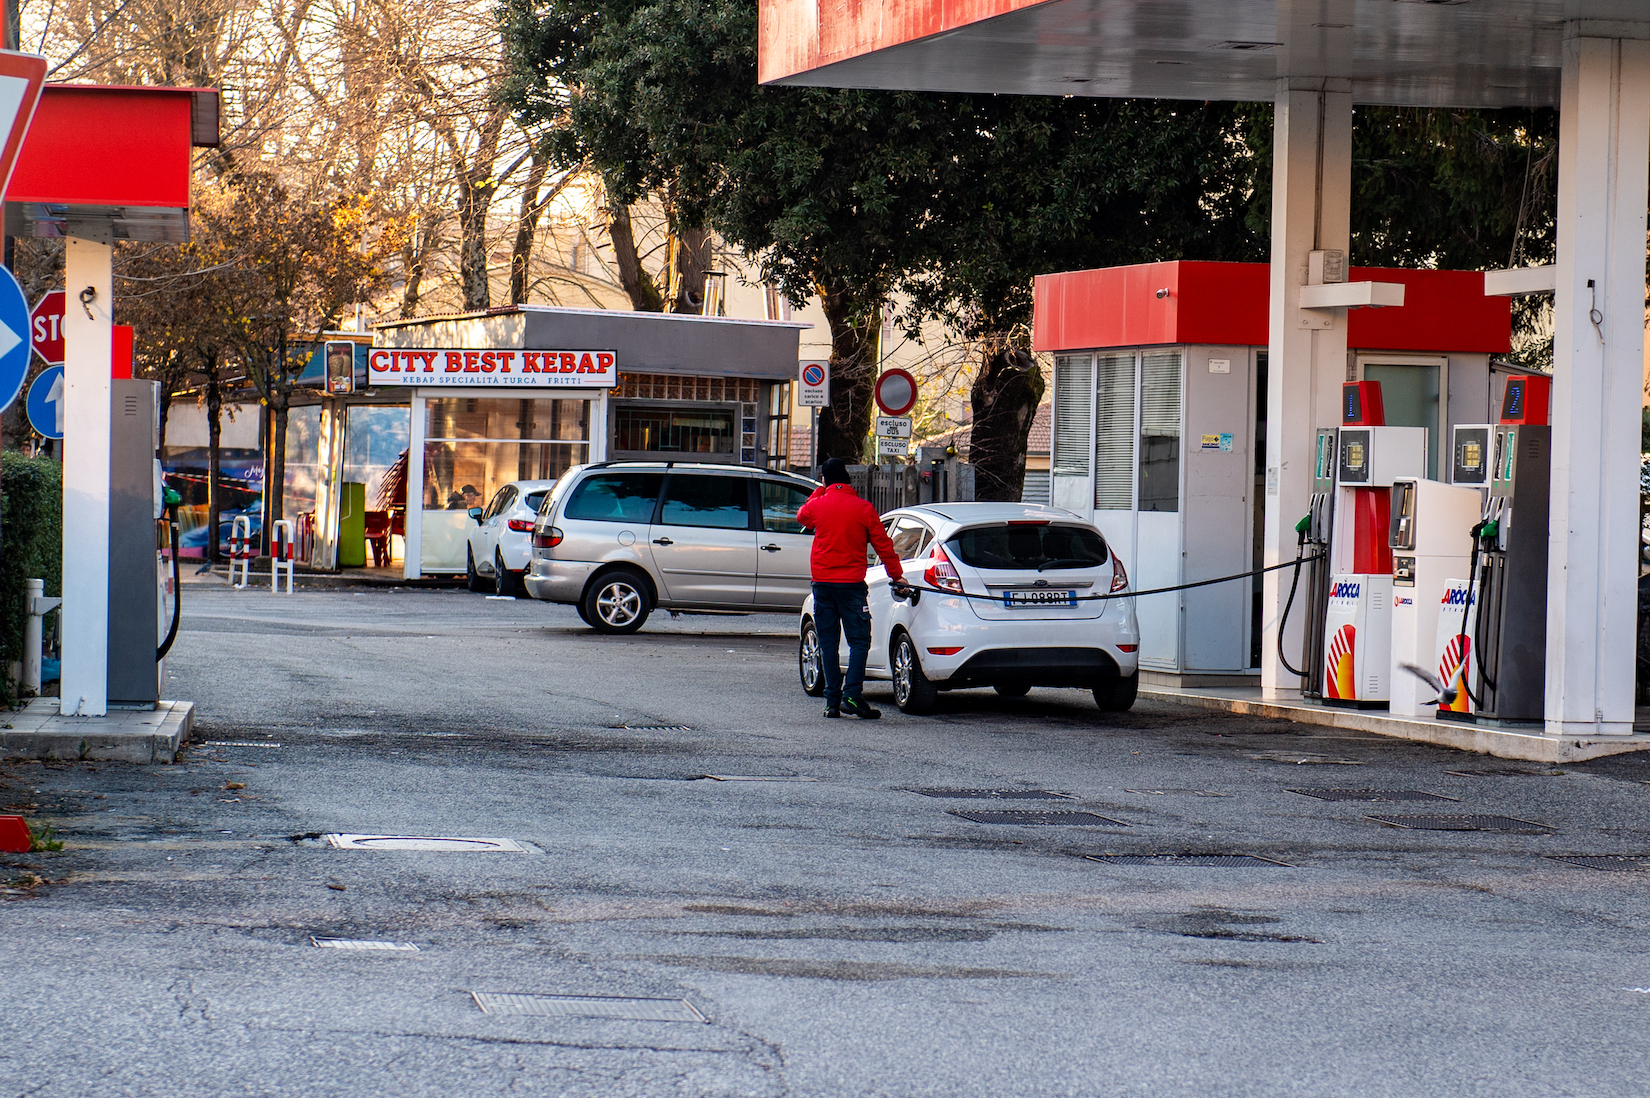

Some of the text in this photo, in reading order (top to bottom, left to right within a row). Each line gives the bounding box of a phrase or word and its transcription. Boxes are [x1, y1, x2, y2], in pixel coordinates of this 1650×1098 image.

[33, 314, 66, 343] ST
[370, 351, 614, 375] CITY BEST KEBAP
[403, 375, 582, 385] KEBAP SPECIALITÀ TURCA FRITTI
[1509, 386, 1520, 414] 2
